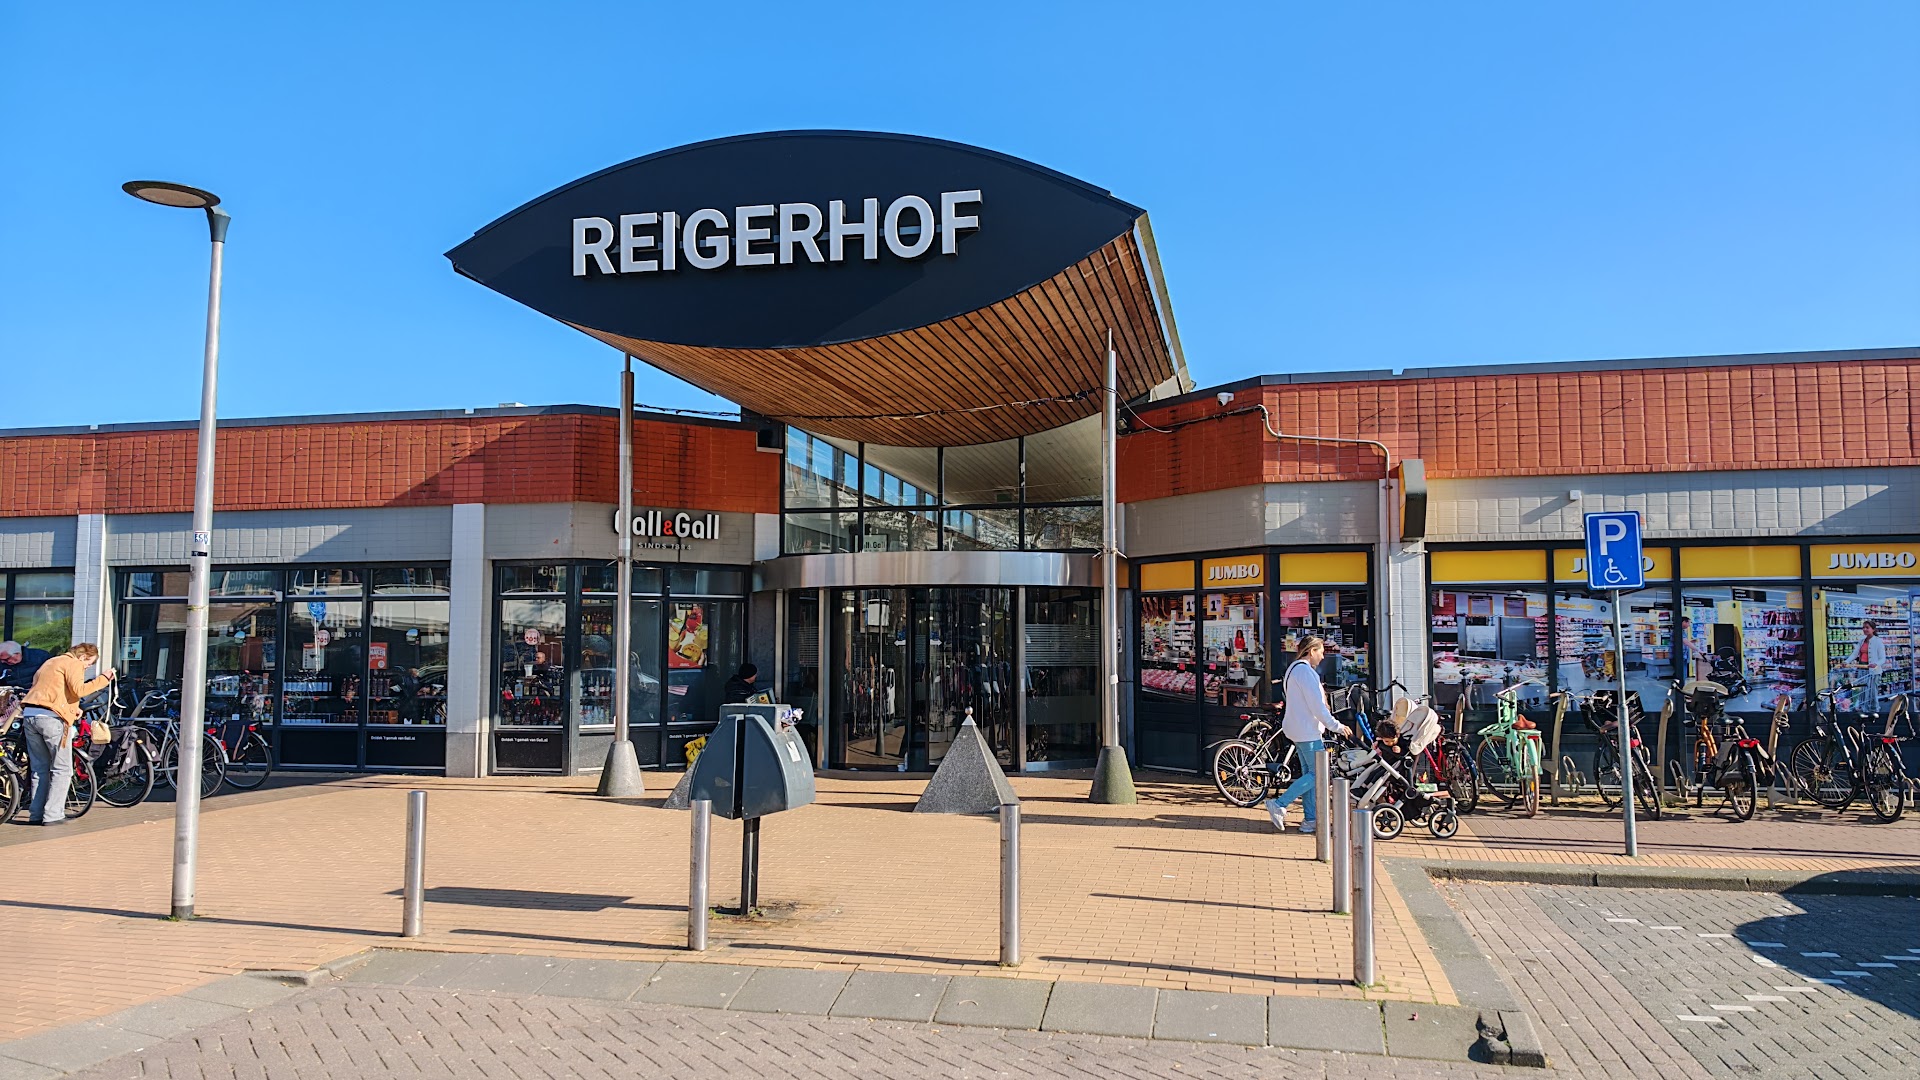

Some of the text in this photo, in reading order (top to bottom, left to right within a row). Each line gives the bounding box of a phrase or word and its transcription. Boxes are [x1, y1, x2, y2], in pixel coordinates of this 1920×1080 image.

[572, 189, 983, 277] REIGERHOF
[638, 542, 667, 550] SINDS
[1598, 518, 1627, 556] P
[1827, 552, 1917, 570] JUMBO
[1207, 563, 1260, 581] JUMBO
